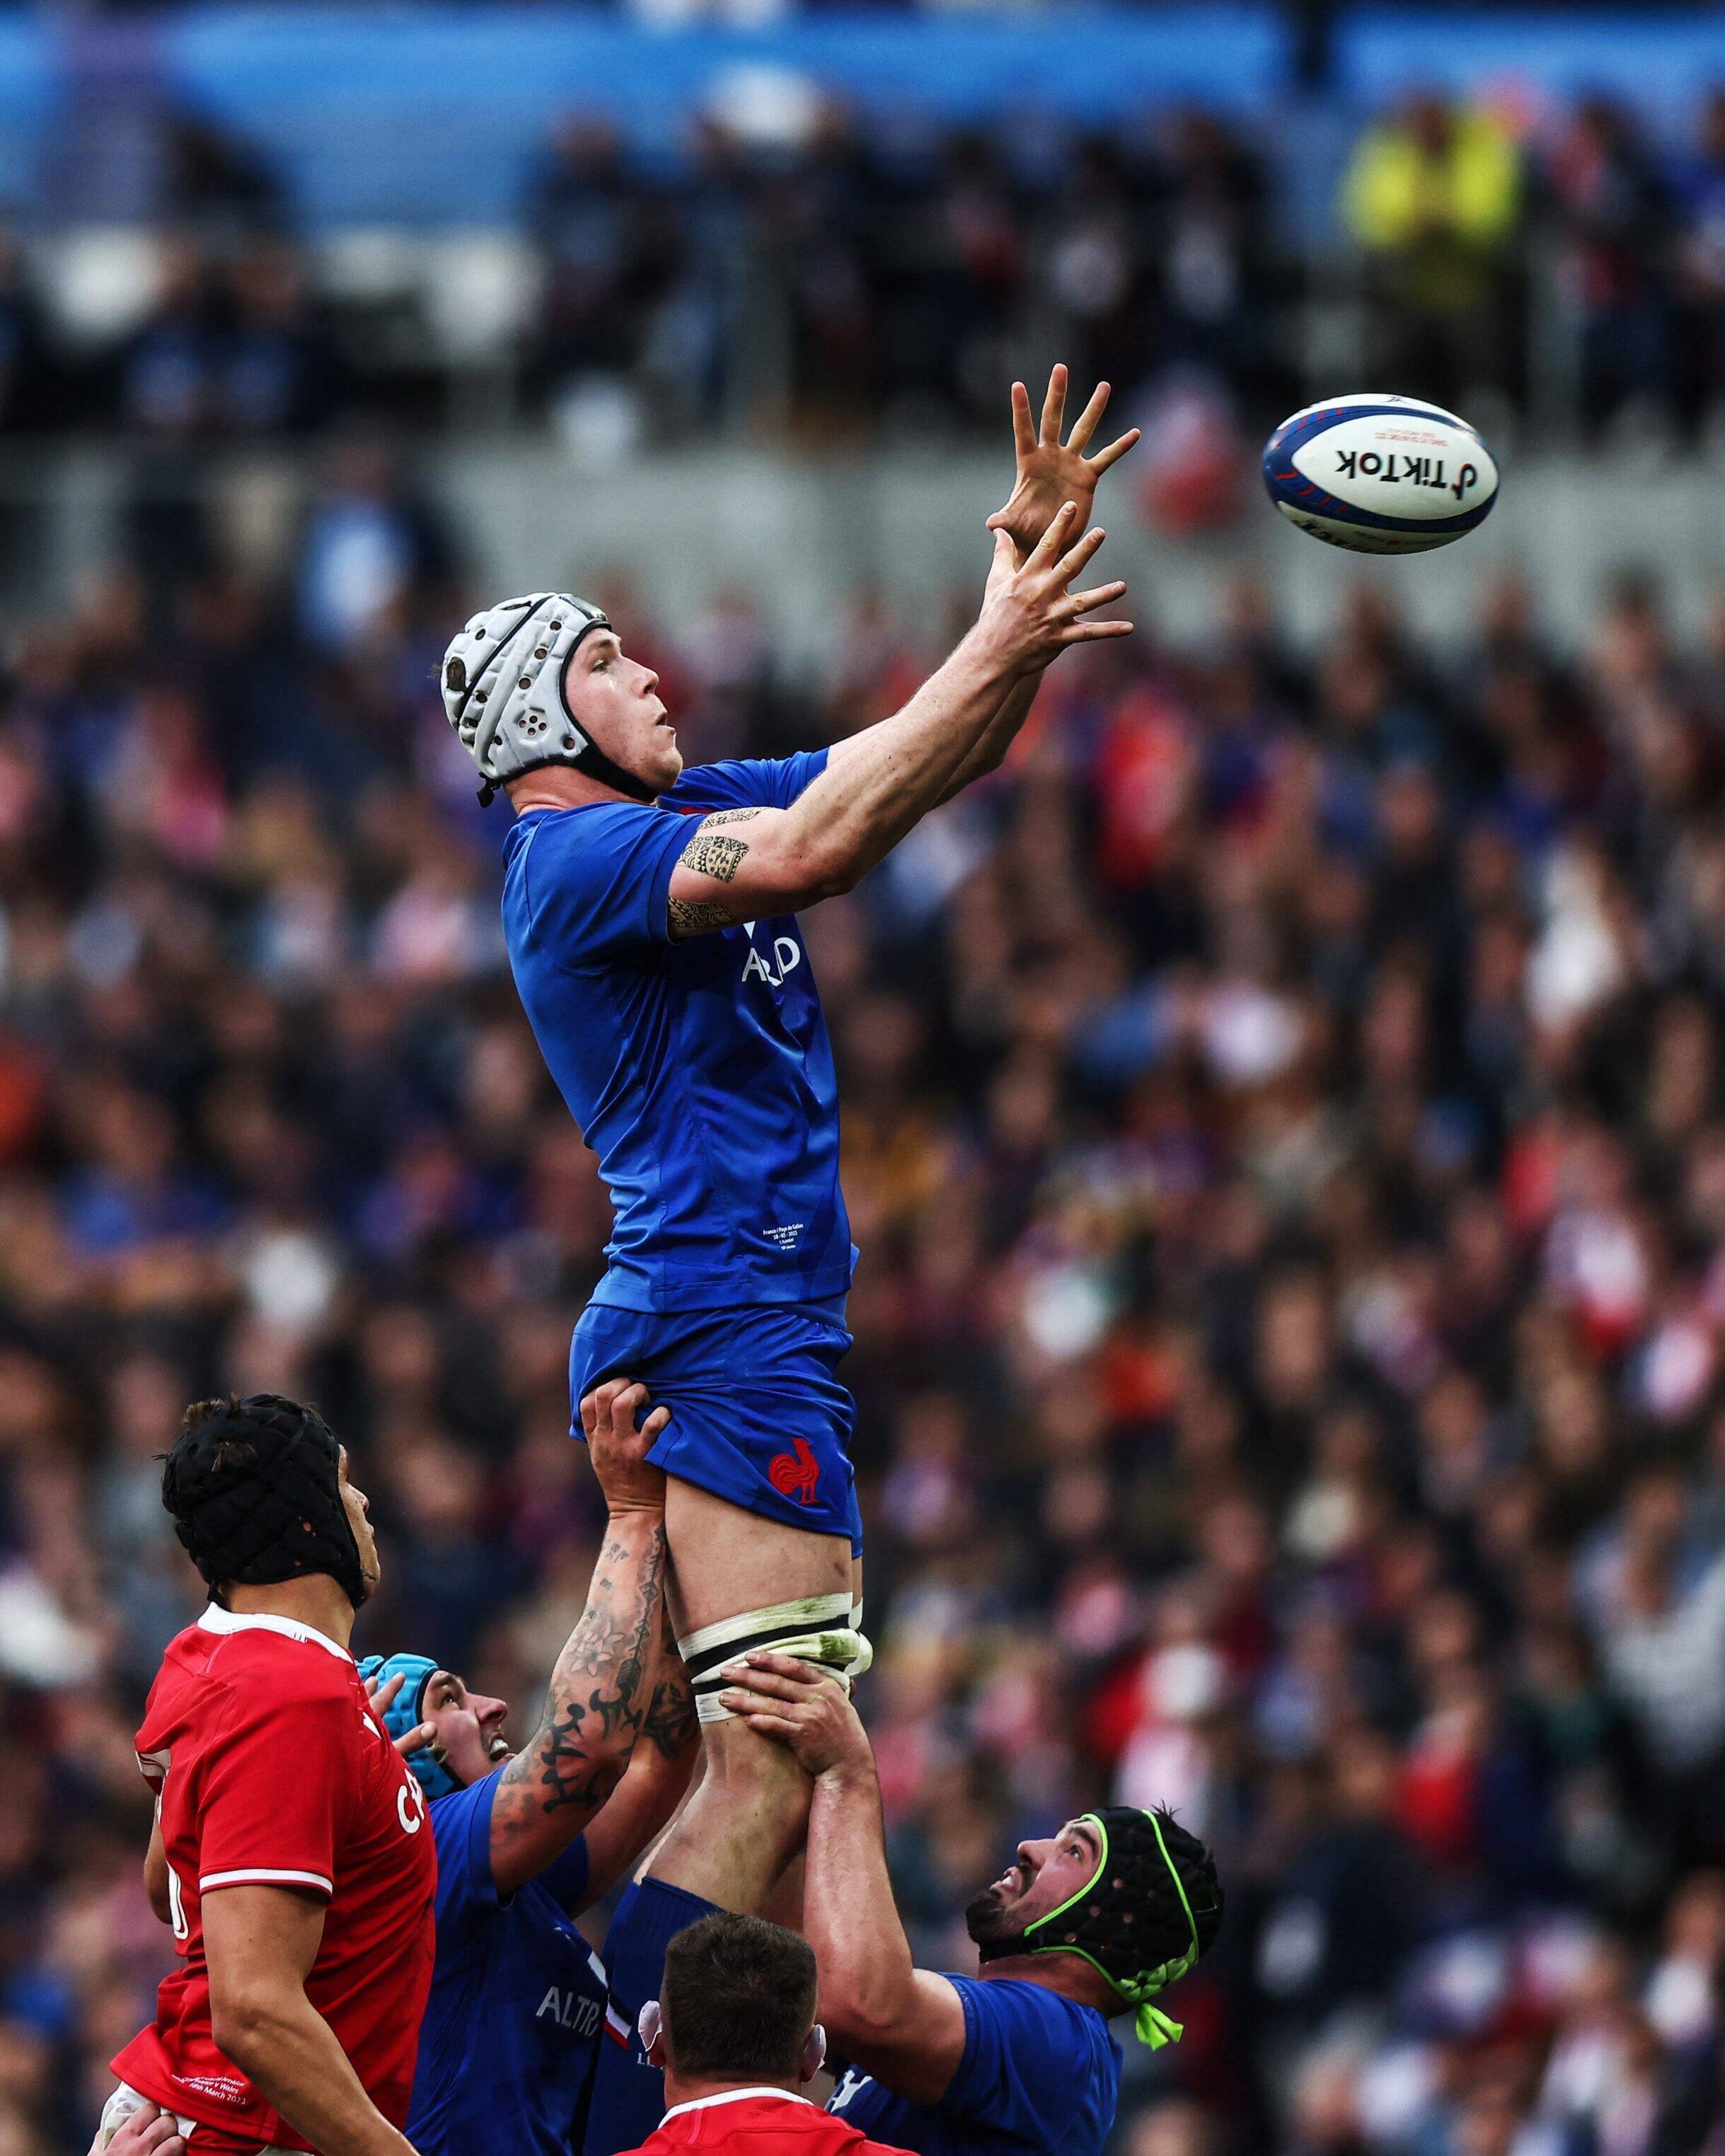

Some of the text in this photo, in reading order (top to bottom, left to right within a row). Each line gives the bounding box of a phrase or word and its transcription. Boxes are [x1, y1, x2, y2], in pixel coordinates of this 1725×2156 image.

[1335, 451, 1447, 489] TikTok
[204, 2086, 226, 2099] March
[226, 2094, 246, 2105] 2023
[220, 2082, 238, 2094] Wales
